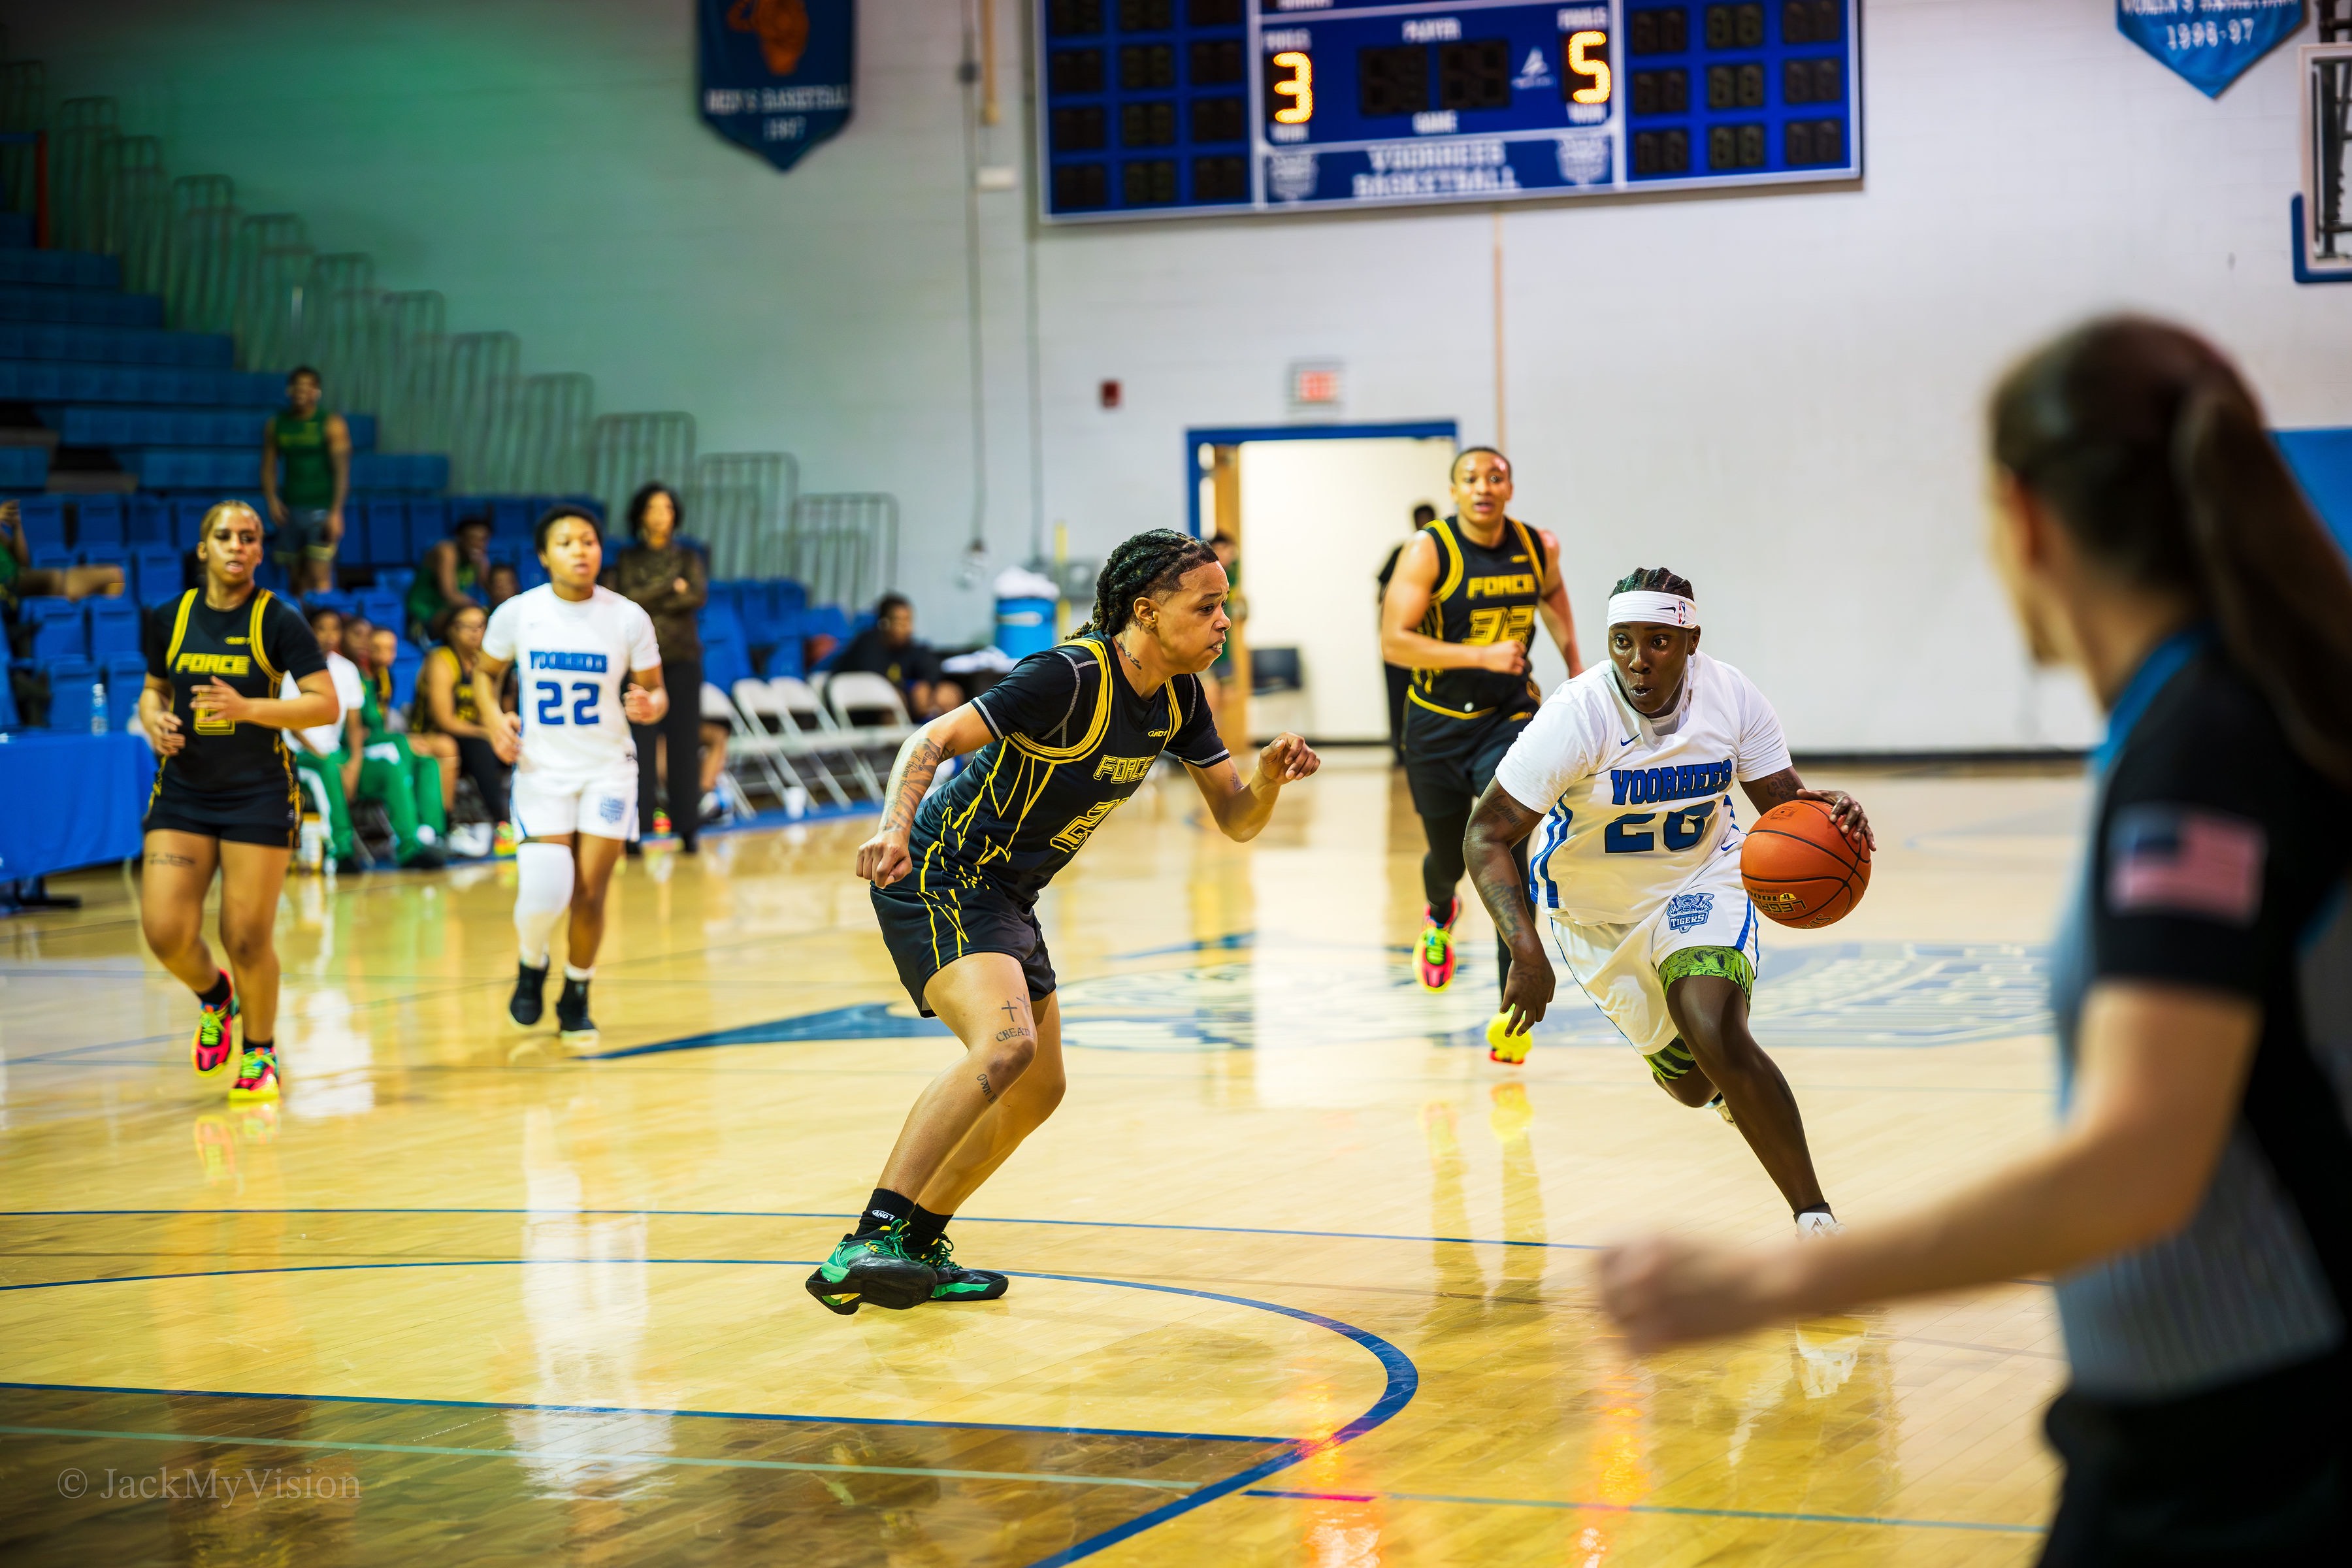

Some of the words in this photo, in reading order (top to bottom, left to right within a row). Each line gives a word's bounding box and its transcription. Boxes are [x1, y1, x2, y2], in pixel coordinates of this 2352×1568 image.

[1569, 31, 1611, 104] 5
[1273, 52, 1313, 123] 3
[1466, 574, 1536, 600] FORCE
[175, 652, 251, 678] FORCE
[536, 681, 600, 725] 22
[1093, 755, 1156, 784] FORCE
[1610, 759, 1732, 805] VOORHEES
[1671, 915, 1706, 927] TIGERS
